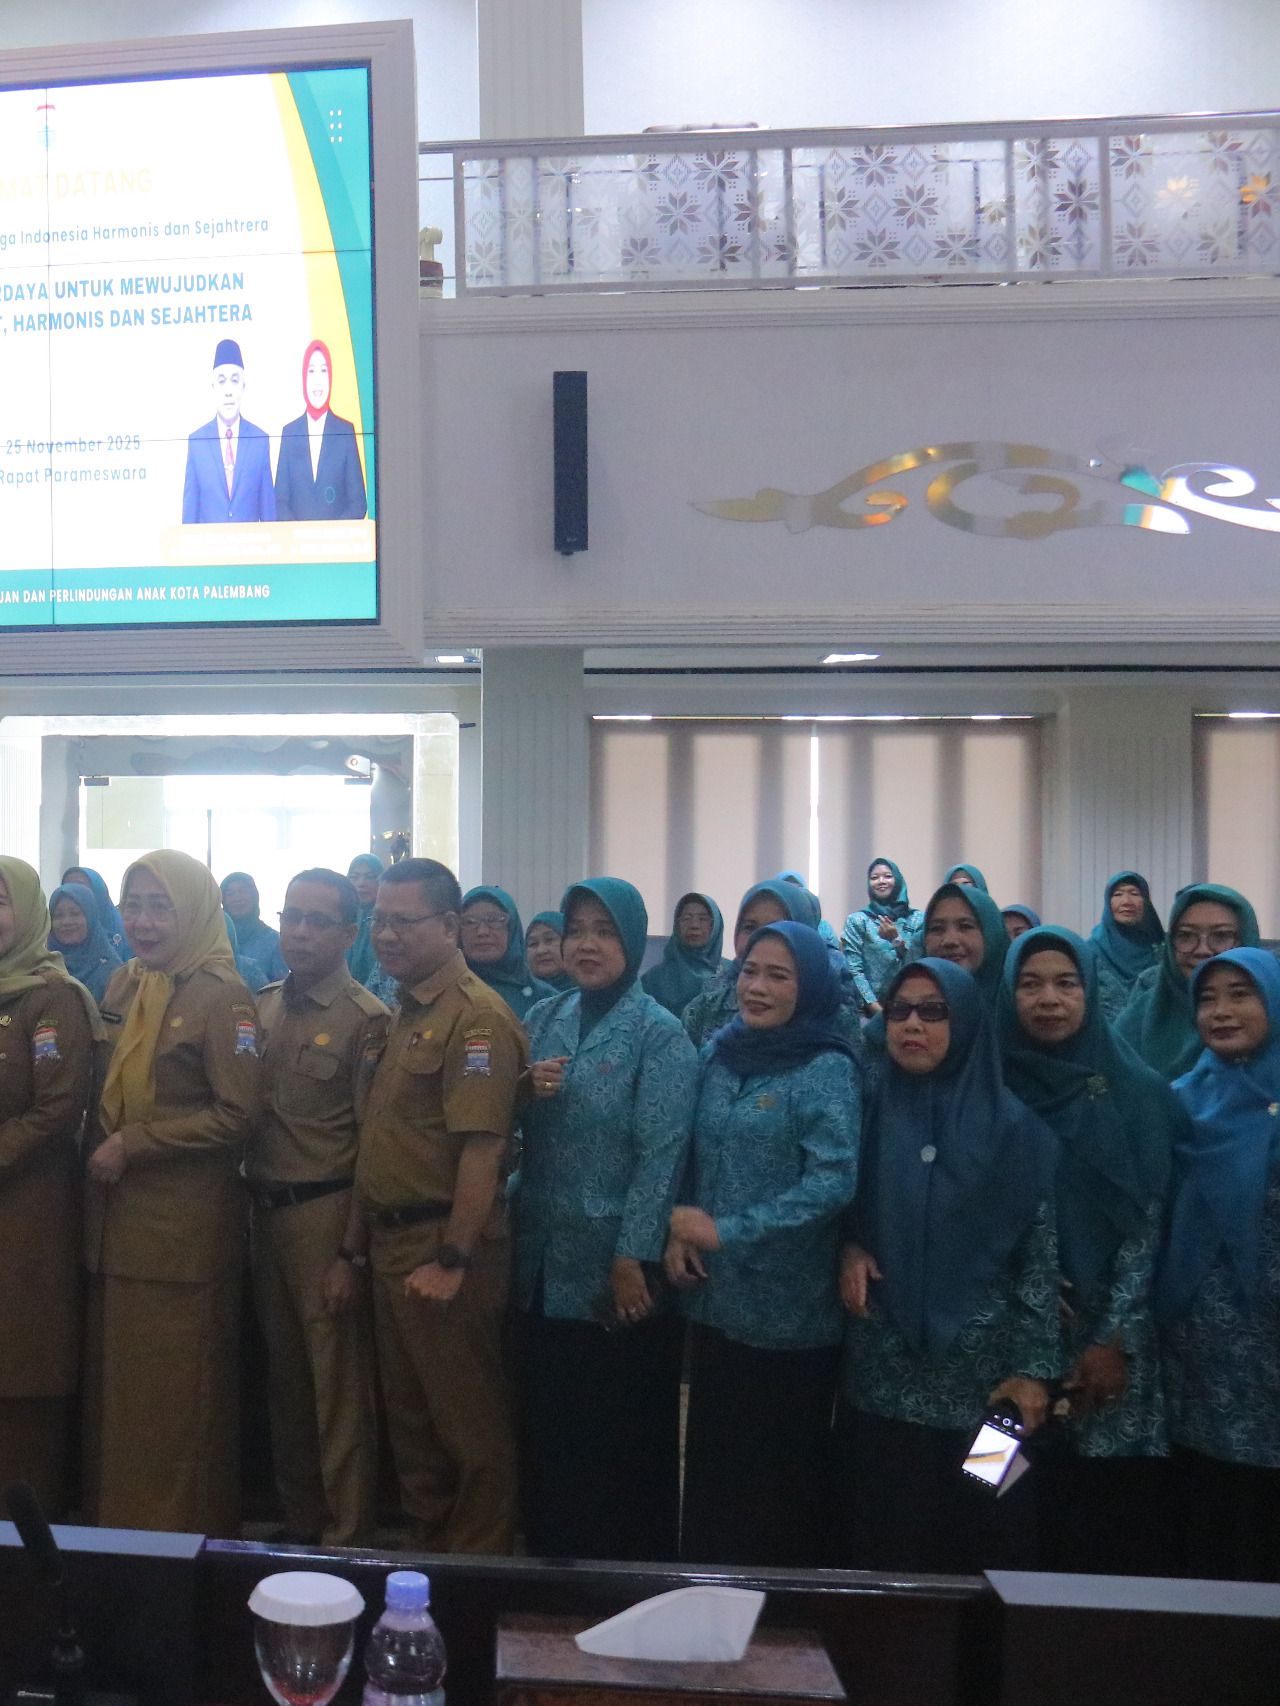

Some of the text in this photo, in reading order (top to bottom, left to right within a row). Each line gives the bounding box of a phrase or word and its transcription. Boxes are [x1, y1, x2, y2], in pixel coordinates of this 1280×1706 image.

[56, 168, 153, 199] DATANG
[21, 225, 88, 244] Indonesia
[93, 221, 159, 239] Harmonis
[165, 222, 190, 236] dan
[195, 218, 269, 238] Sejahtrera
[55, 278, 114, 299] UNTUK
[121, 272, 244, 296] MEWUJUDKAN
[13, 310, 103, 332] HARMONIS
[110, 308, 145, 327] DAN
[151, 304, 253, 325] SEJAHTERA
[6, 440, 21, 455] 25
[27, 437, 102, 454] November
[107, 435, 141, 451] 2025
[45, 466, 147, 483] Parameswara
[23, 589, 46, 603] DAN
[49, 586, 133, 603] PERLINDUNGAN
[136, 586, 166, 600] ANAK
[170, 585, 200, 600] KOTA
[204, 584, 270, 599] PALEMBANG
